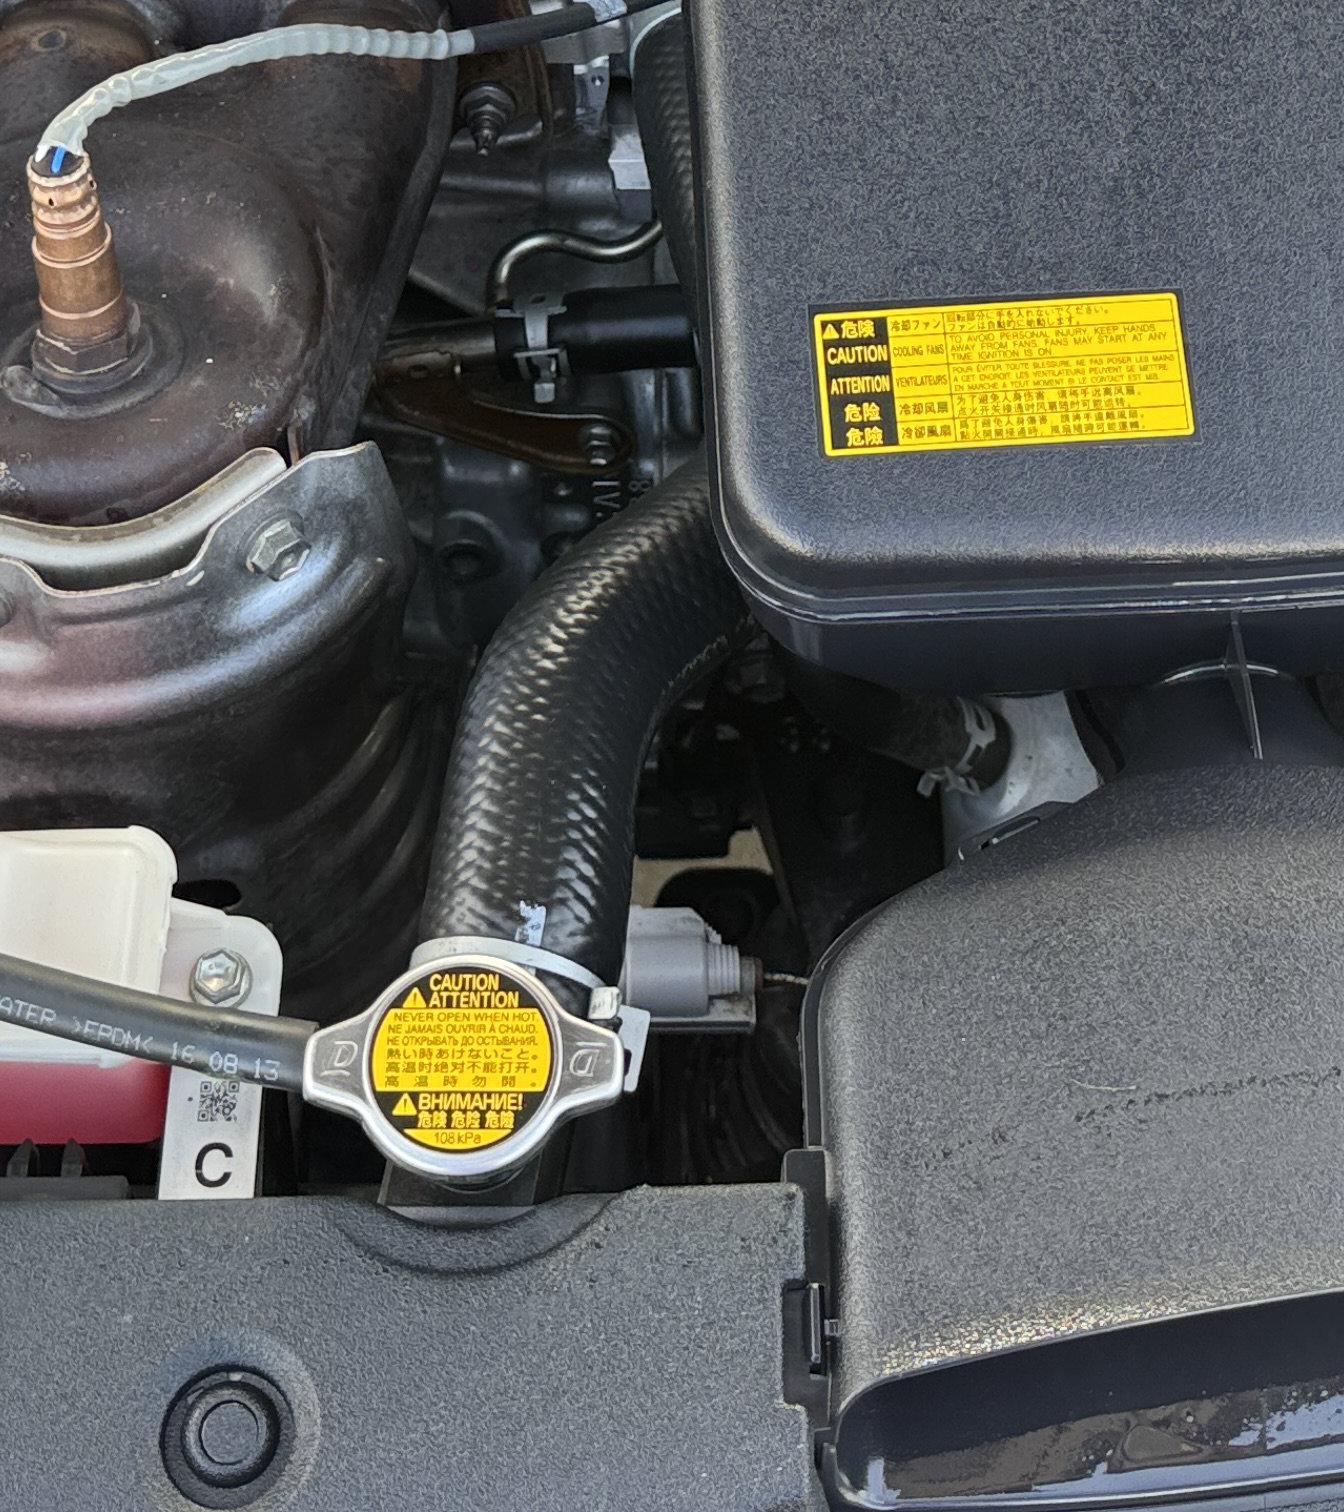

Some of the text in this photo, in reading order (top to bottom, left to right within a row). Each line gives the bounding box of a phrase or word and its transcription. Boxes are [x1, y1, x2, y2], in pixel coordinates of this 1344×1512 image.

[840, 319, 876, 339] 危険
[949, 323, 1156, 344] TO AVOID PERSONAL KEEP HANDS
[892, 343, 945, 357] COOLING FANS
[950, 331, 1168, 353] AWAY FROM FANS MAY START AT ANY
[826, 344, 889, 365] CAUTION
[951, 348, 1034, 361] TIME IGNITION IS
[830, 374, 891, 396] ATTENTION
[895, 374, 949, 388] VENTILATEURS
[844, 402, 882, 423] 危险
[899, 400, 949, 416] 冷却风扇
[845, 425, 884, 447] 危險
[429, 973, 500, 991] CAUTION
[428, 991, 520, 1008] ATTENTION
[393, 1011, 539, 1022] NEVER OPEN WHEN HOT.
[387, 1022, 539, 1034] NE JAMAIS OUVRIR À CHAUD.
[70, 1015, 155, 1054] >EPDM<
[170, 1040, 196, 1065] 16
[208, 1050, 239, 1074] 08
[252, 1058, 281, 1082] 13
[386, 1035, 539, 1047] НЕ ОТКРЫВАТЬ ДО ОСТЫВАНИЯ.
[418, 1093, 524, 1110] ВНИМАНИЕ!
[193, 1141, 234, 1188] C
